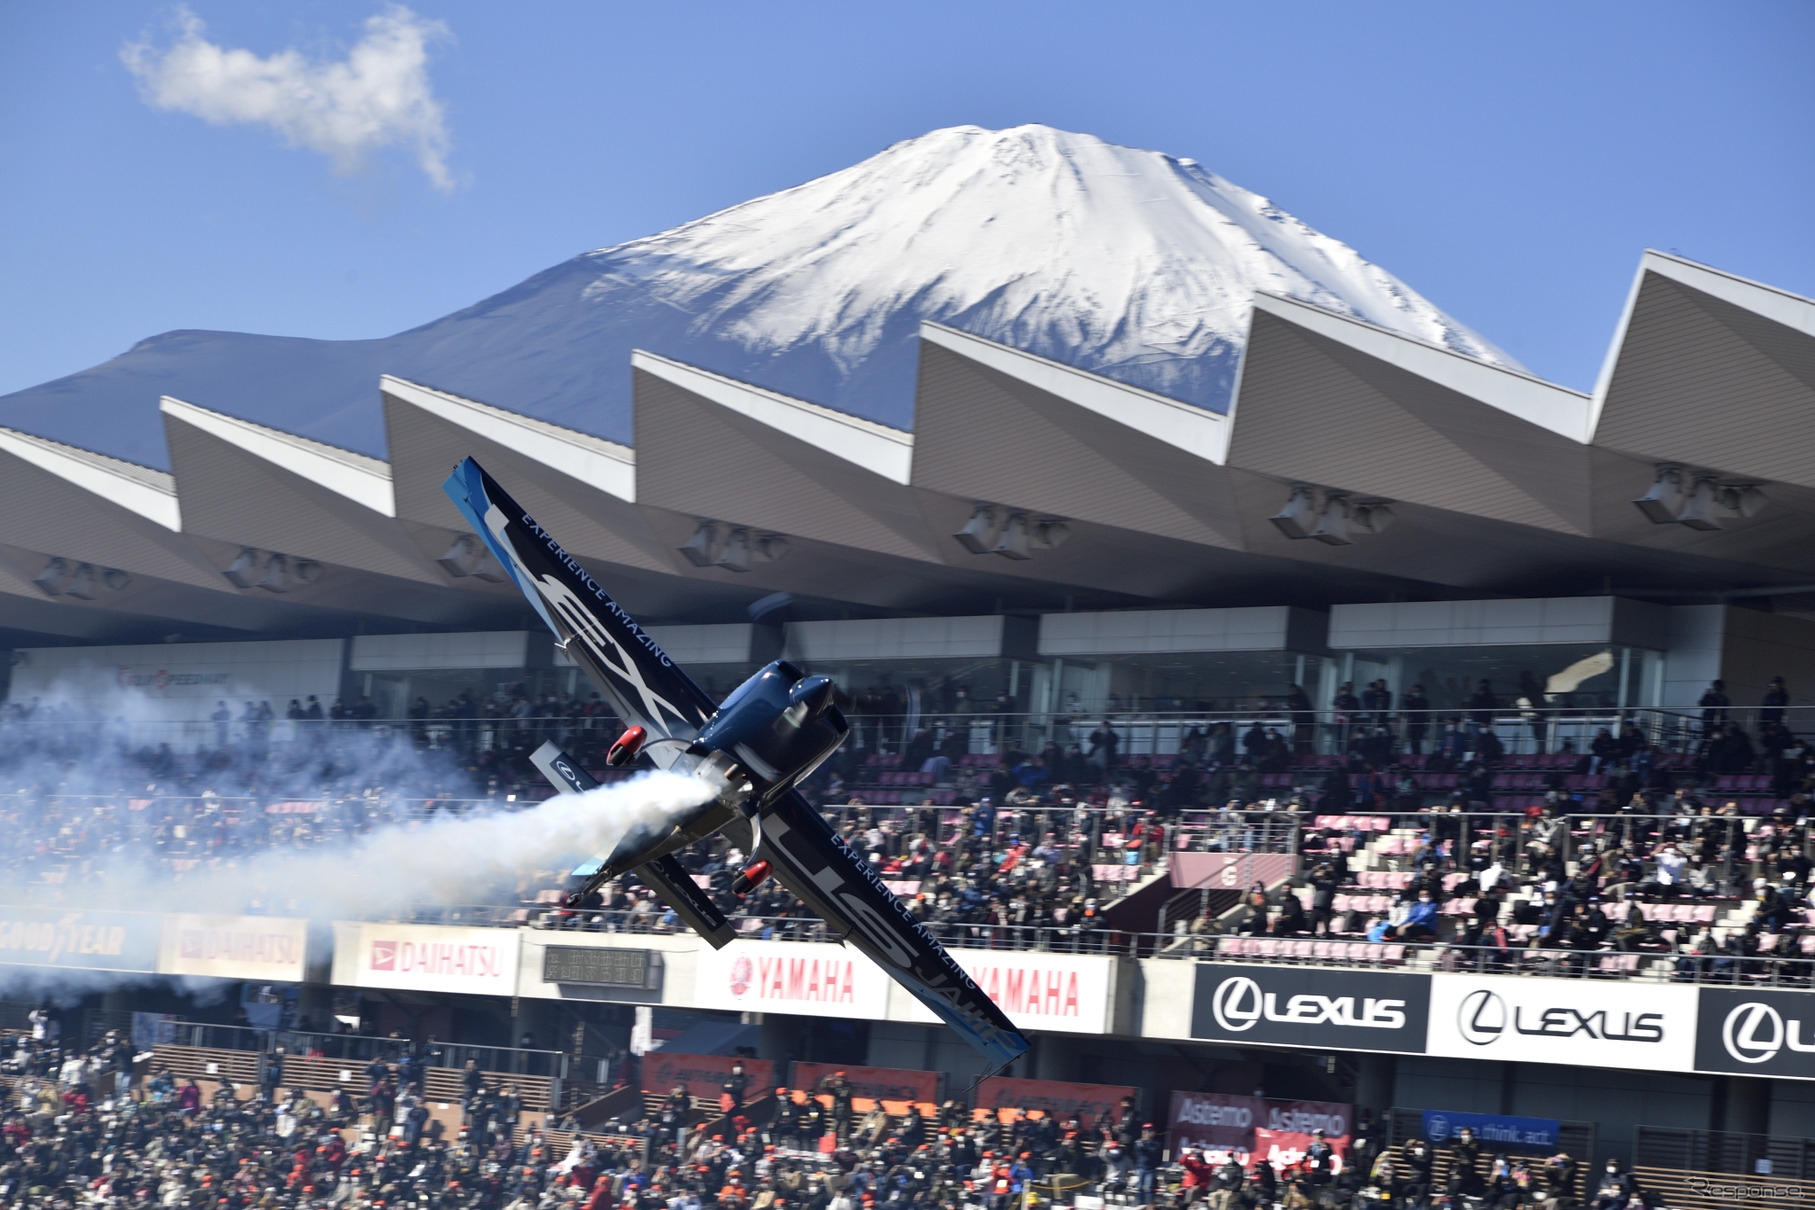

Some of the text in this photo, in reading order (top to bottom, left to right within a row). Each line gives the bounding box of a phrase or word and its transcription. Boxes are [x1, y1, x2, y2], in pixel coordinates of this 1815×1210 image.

[522, 513, 672, 668] EXPERIENCE AMAZING
[830, 832, 976, 990] EXPERIENCE AMAZING
[401, 942, 500, 978] DAIHATSU
[759, 957, 853, 1003] YAMAHA
[973, 967, 1079, 1017] YAMAHA
[1263, 993, 1406, 1029] LEXUS
[1515, 1006, 1664, 1043] LEXUS
[1176, 1098, 1253, 1128] Astemo
[1267, 1107, 1346, 1137] Astemo
